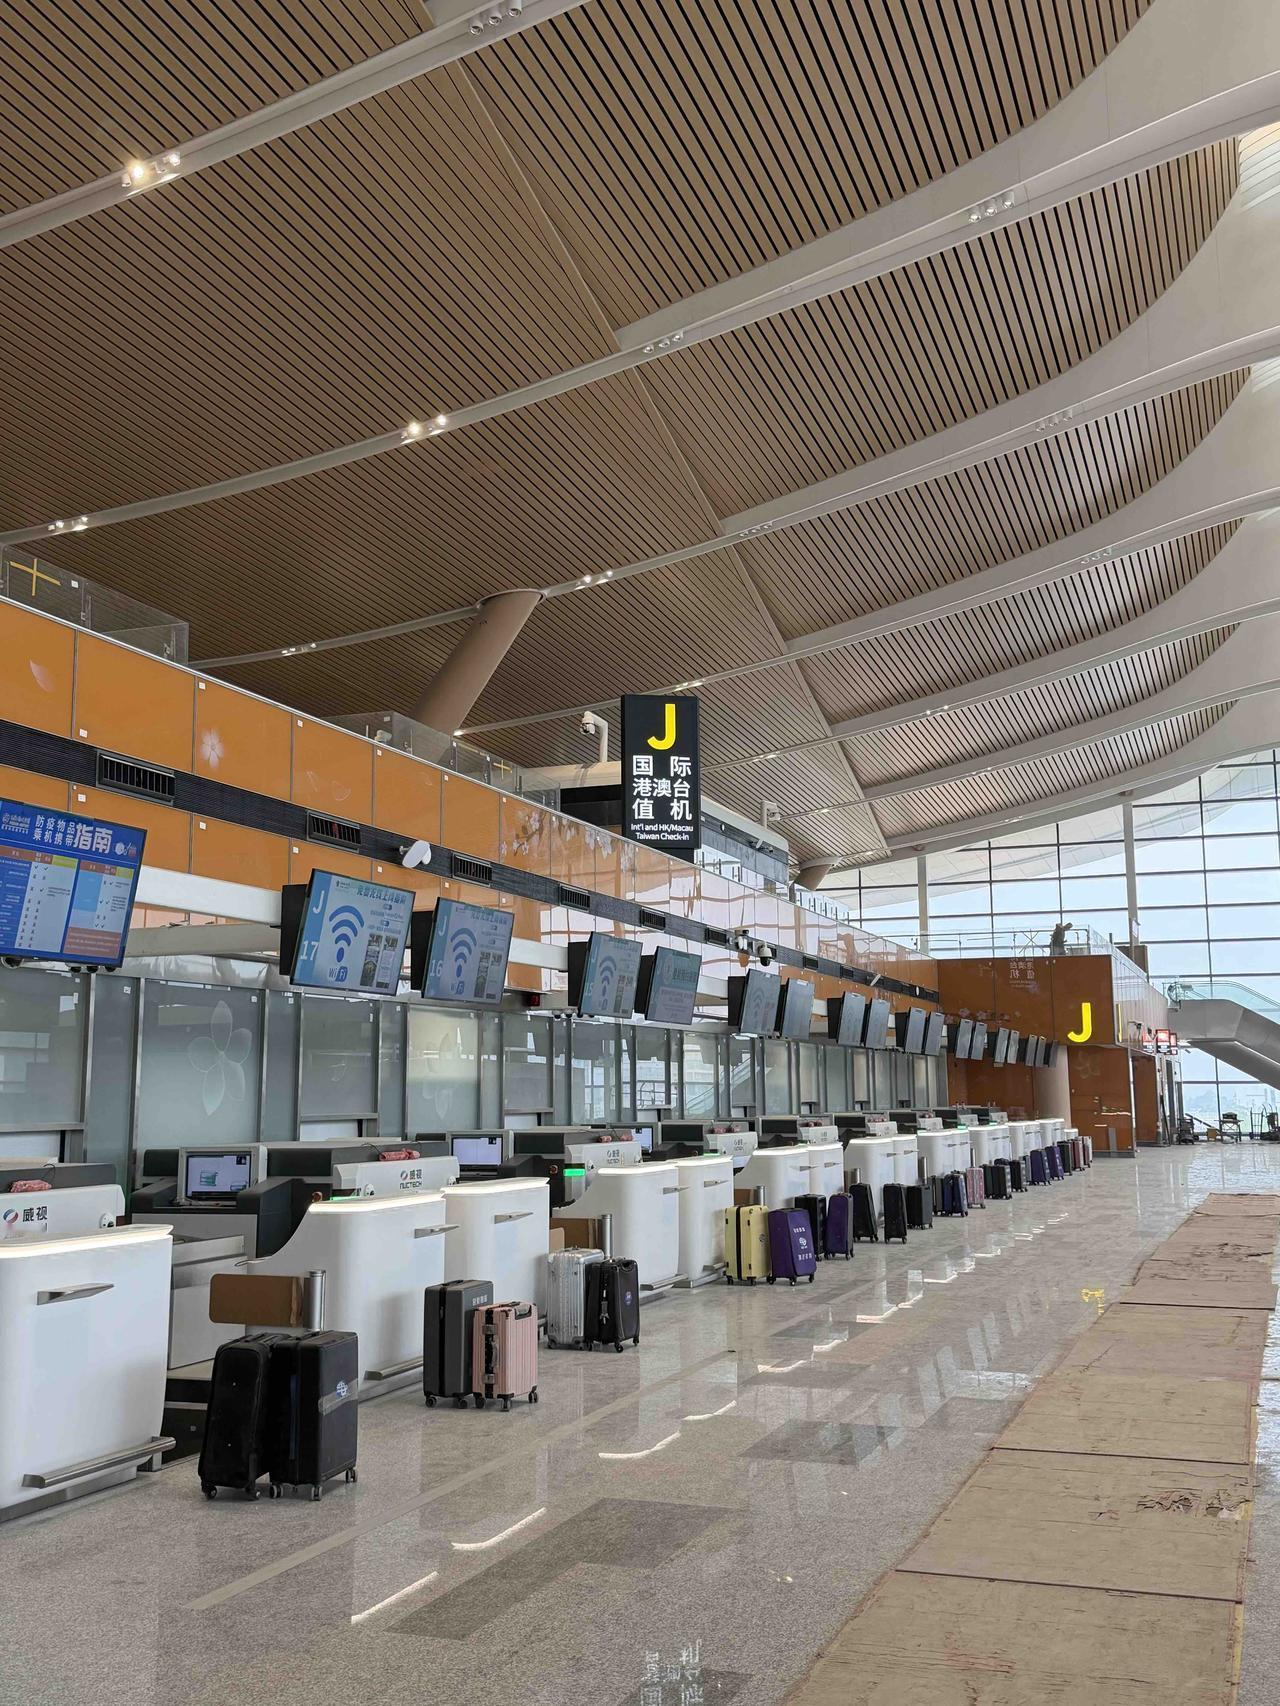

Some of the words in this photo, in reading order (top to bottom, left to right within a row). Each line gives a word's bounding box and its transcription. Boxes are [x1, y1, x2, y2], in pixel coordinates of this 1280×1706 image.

[647, 703, 676, 750] J
[632, 755, 692, 777] 国际
[632, 778, 691, 798] 港澳台
[632, 798, 692, 821] 值机
[35, 814, 76, 835] 防疫物品
[645, 824, 658, 832] and
[659, 824, 693, 833] HK/Macau
[33, 828, 74, 847] 乘机携带
[73, 822, 113, 854] 指南
[636, 832, 660, 841] Taiwan
[661, 833, 689, 842] Check-in
[312, 890, 325, 914] J
[438, 915, 448, 936] J
[299, 940, 319, 961] 17
[429, 959, 443, 977] 16
[1067, 1002, 1093, 1043] J
[22, 1205, 48, 1222] 威视
